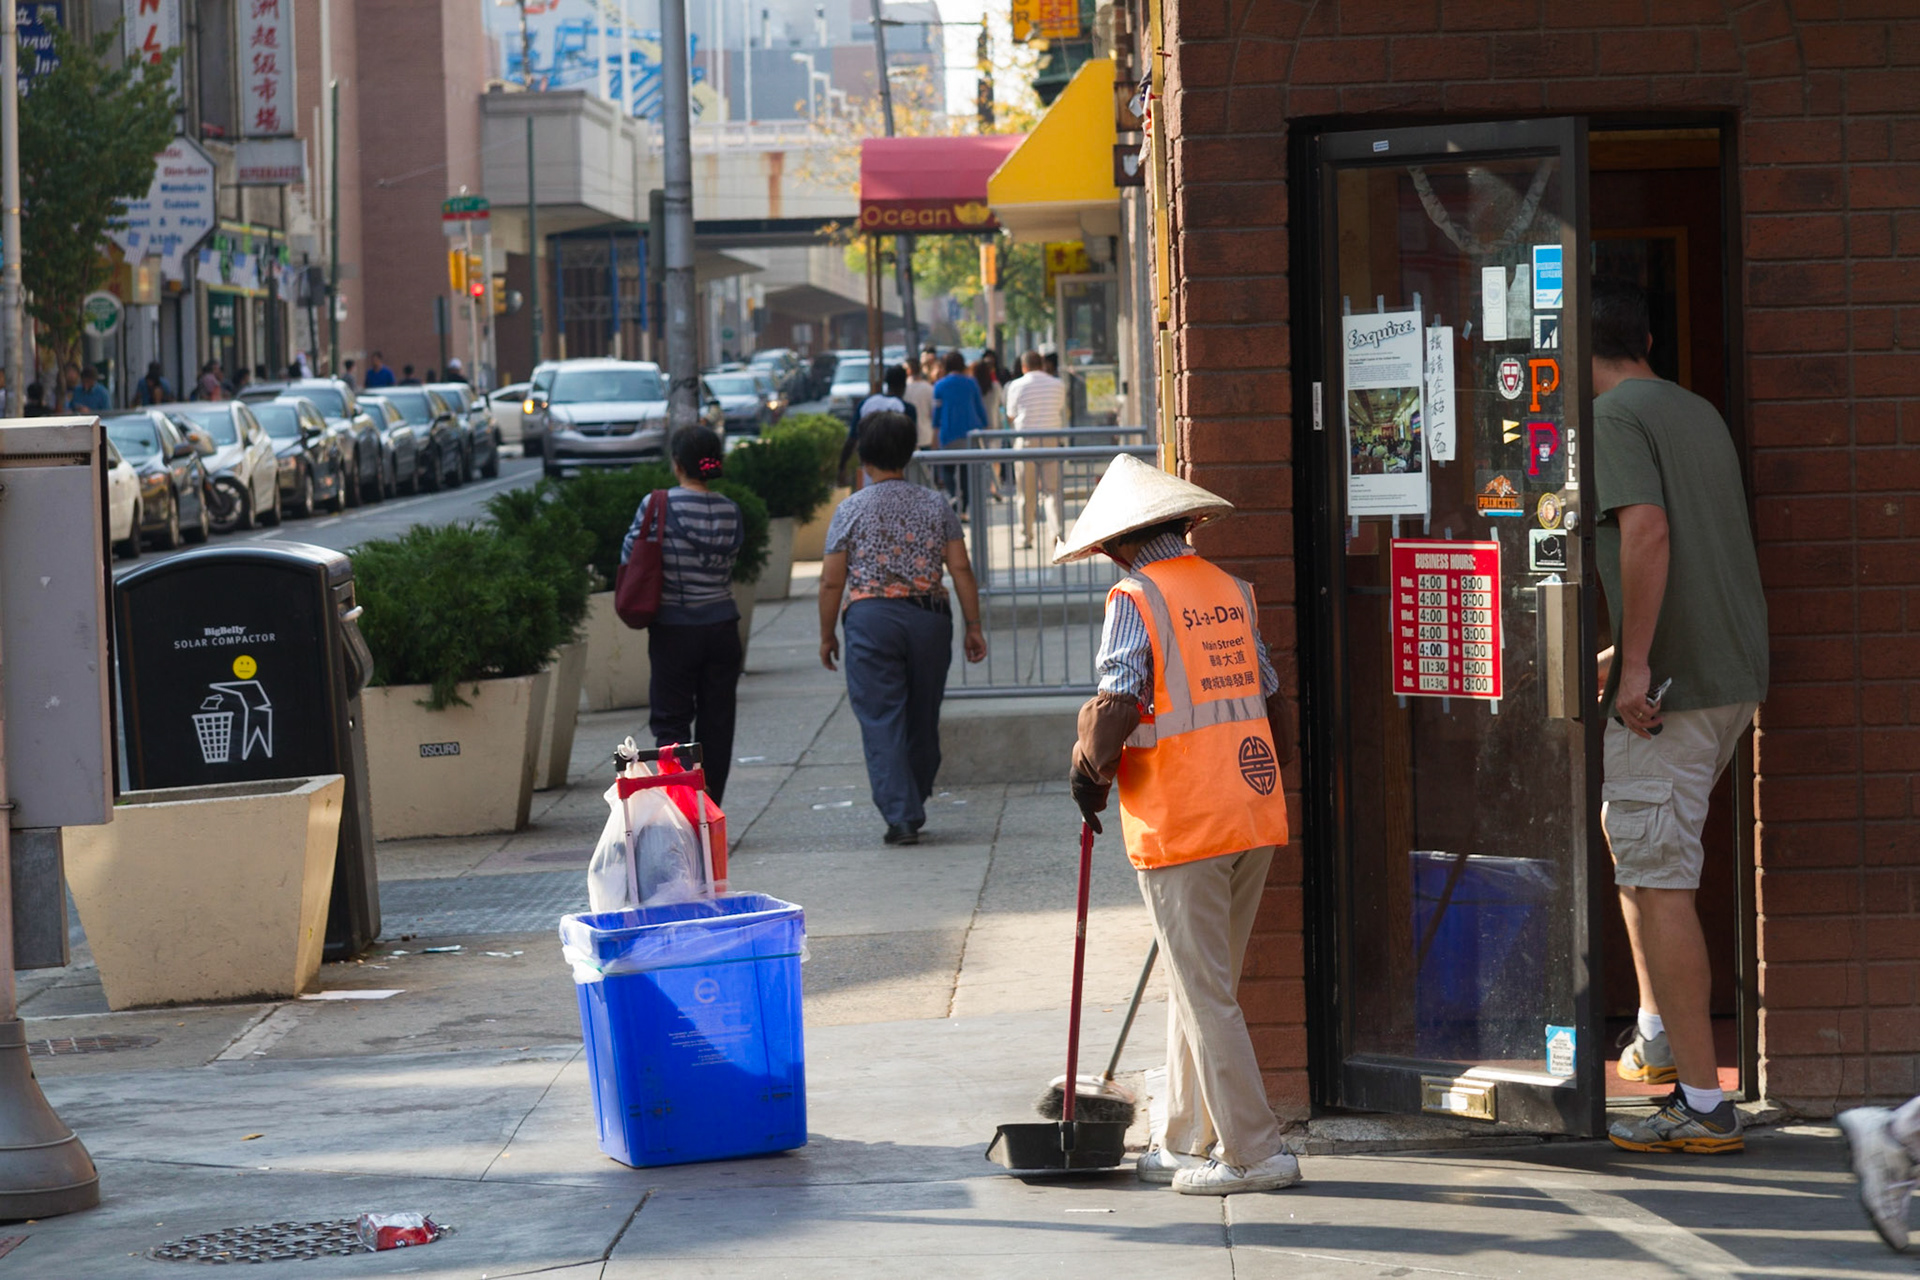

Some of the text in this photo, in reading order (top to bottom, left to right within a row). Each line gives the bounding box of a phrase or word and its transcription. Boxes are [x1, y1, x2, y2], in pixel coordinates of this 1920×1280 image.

[862, 205, 952, 226] Ocean
[1347, 320, 1416, 349] Esquire
[1567, 428, 1576, 482] PULL
[1478, 496, 1520, 509] PRINCETO
[1415, 553, 1476, 570] BUSINESS HOURS:
[1420, 575, 1442, 589] 4:00
[1461, 576, 1483, 590] 3:00
[1420, 592, 1442, 606] 4:00
[1462, 593, 1484, 607] 3:00
[1183, 606, 1244, 630] $1-a-Day
[1420, 609, 1442, 622] 4:00
[1462, 610, 1485, 624] 3:00
[204, 625, 247, 637] BigBelly
[1420, 626, 1442, 639] 4:00
[1463, 627, 1486, 640] 3:00
[174, 633, 276, 649] SOLAR COMPACTOR
[1217, 636, 1246, 650] Street
[1420, 643, 1442, 656] 4:00
[1464, 644, 1486, 658] 4:00
[1422, 660, 1446, 673] 11:30
[1465, 661, 1487, 675] 4:00
[1422, 677, 1444, 689] 11:30
[1464, 677, 1488, 691] 3:00
[421, 743, 459, 756] OSCURO
